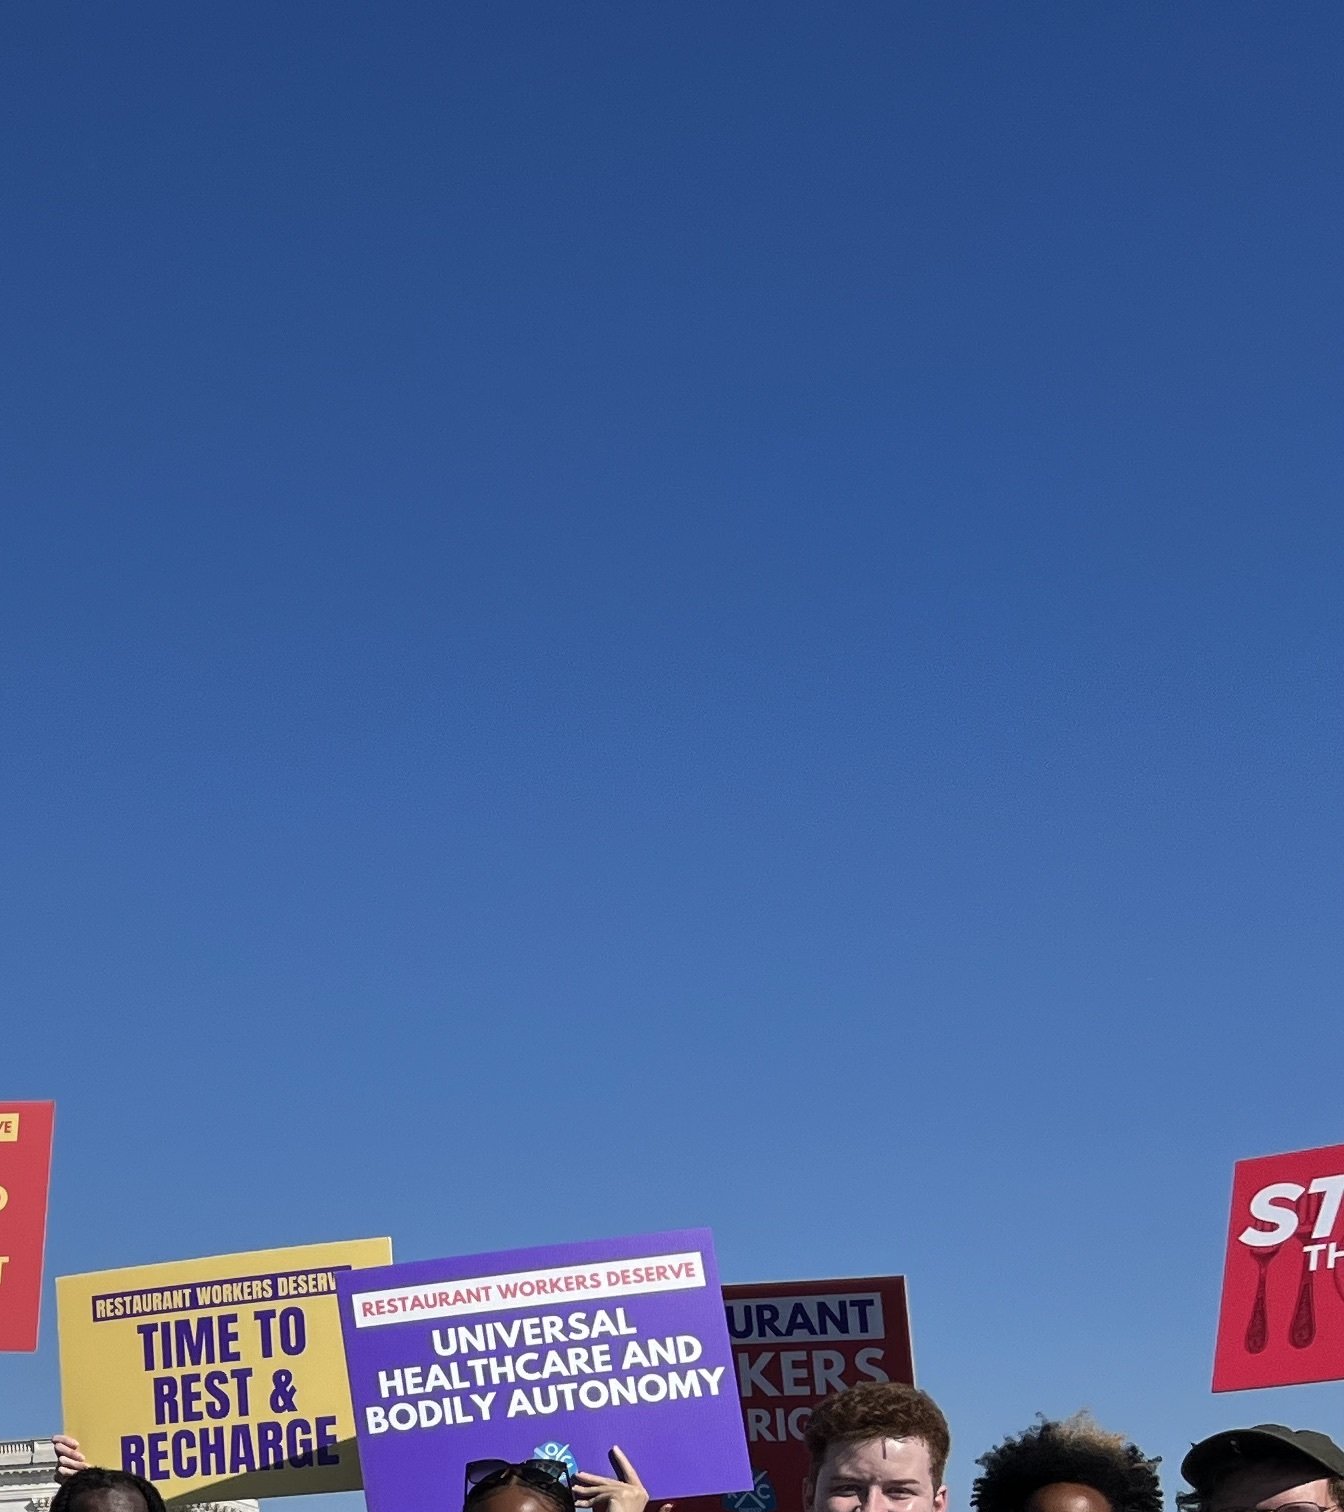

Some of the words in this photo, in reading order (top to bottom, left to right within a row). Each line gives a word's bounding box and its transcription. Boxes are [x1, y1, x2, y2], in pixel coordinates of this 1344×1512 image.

[95, 1288, 192, 1320] RESTAURANT
[196, 1278, 273, 1306] WORKERS
[361, 1285, 492, 1318] RESTAURANT
[496, 1273, 602, 1300] WORKERS
[607, 1261, 696, 1288] DESERVE
[136, 1312, 241, 1372] TIME
[253, 1306, 307, 1359] TO
[431, 1307, 638, 1358] UNIVERSAL
[152, 1367, 253, 1426] REST
[268, 1368, 298, 1414] &
[377, 1345, 614, 1399] HEALTHCARE
[621, 1335, 703, 1371] AND
[365, 1391, 497, 1436] BODILY
[506, 1366, 726, 1419] AUTONOMY
[120, 1415, 340, 1482] RECHARGE
